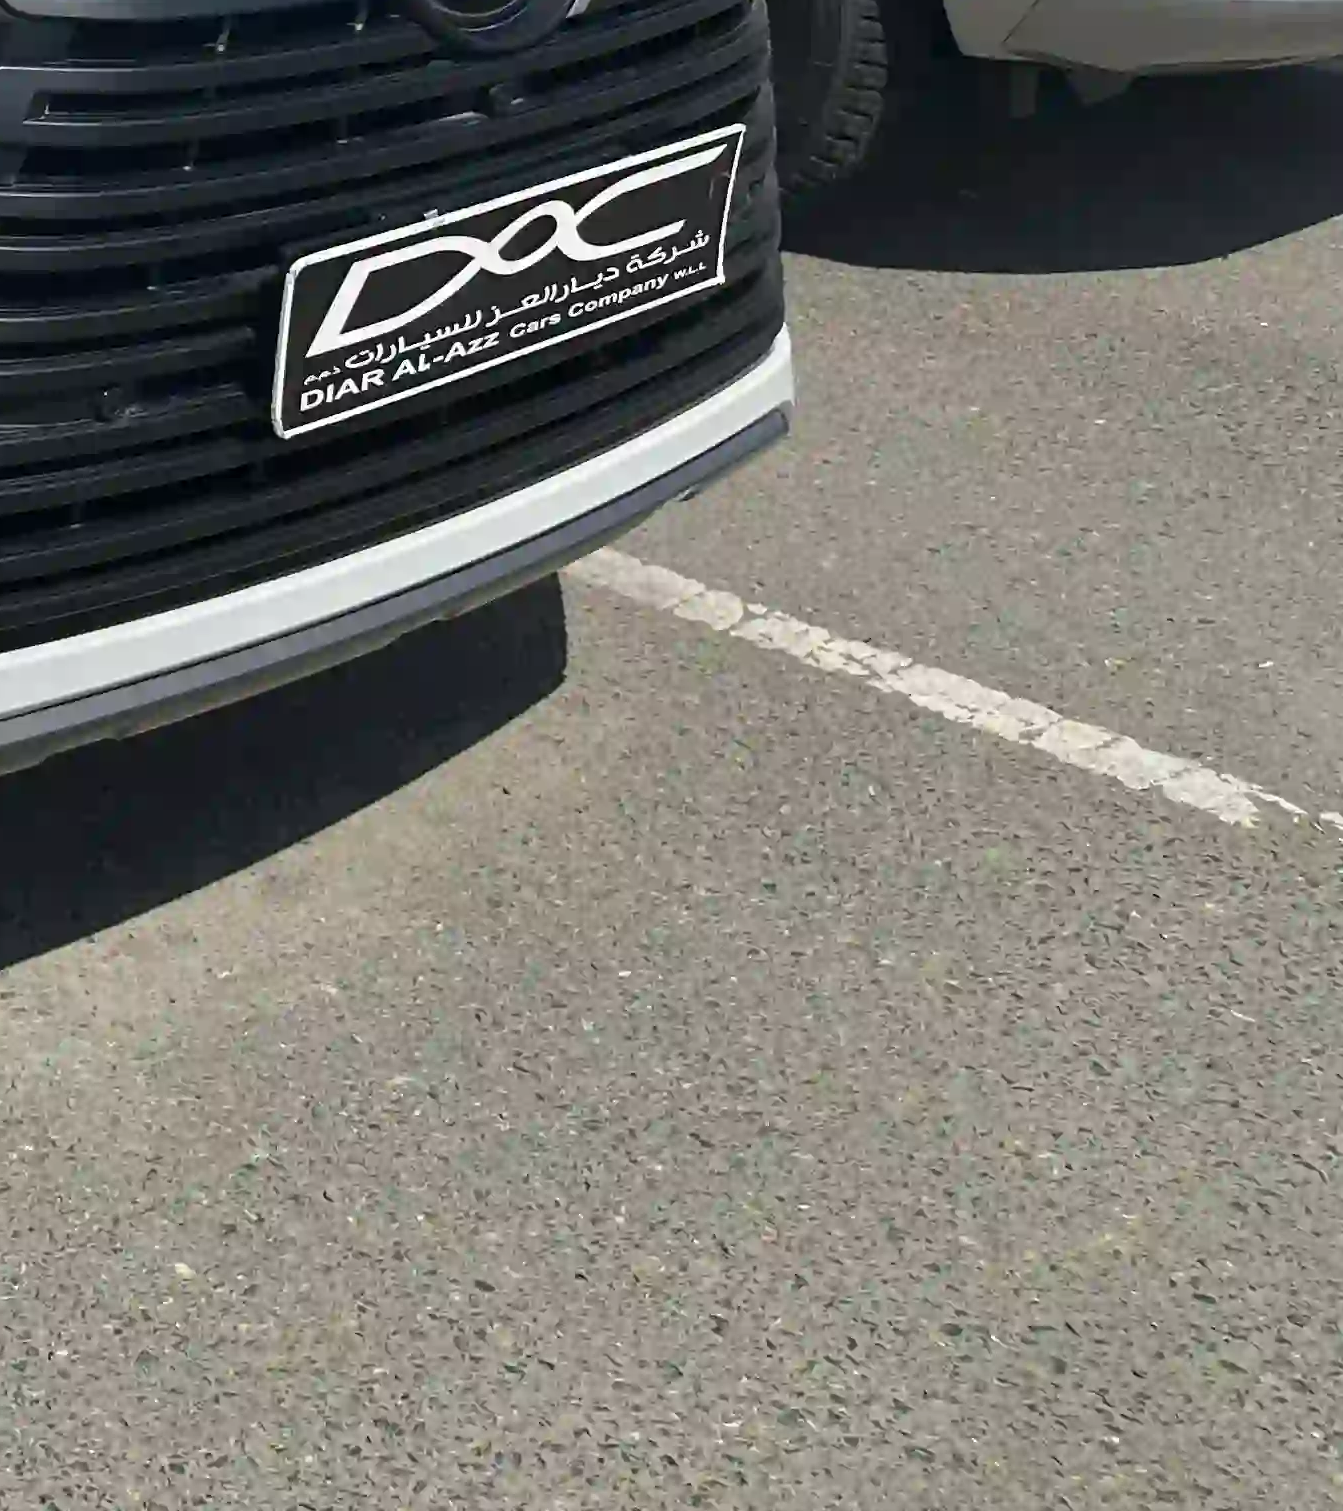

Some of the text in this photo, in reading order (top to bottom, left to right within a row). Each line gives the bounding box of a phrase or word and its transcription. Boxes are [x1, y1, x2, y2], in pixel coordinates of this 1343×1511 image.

[625, 229, 711, 274] شركة
[299, 368, 385, 412] DIAR
[509, 311, 562, 339] Cars
[567, 272, 670, 318] Company
[344, 308, 483, 370] للسيارات
